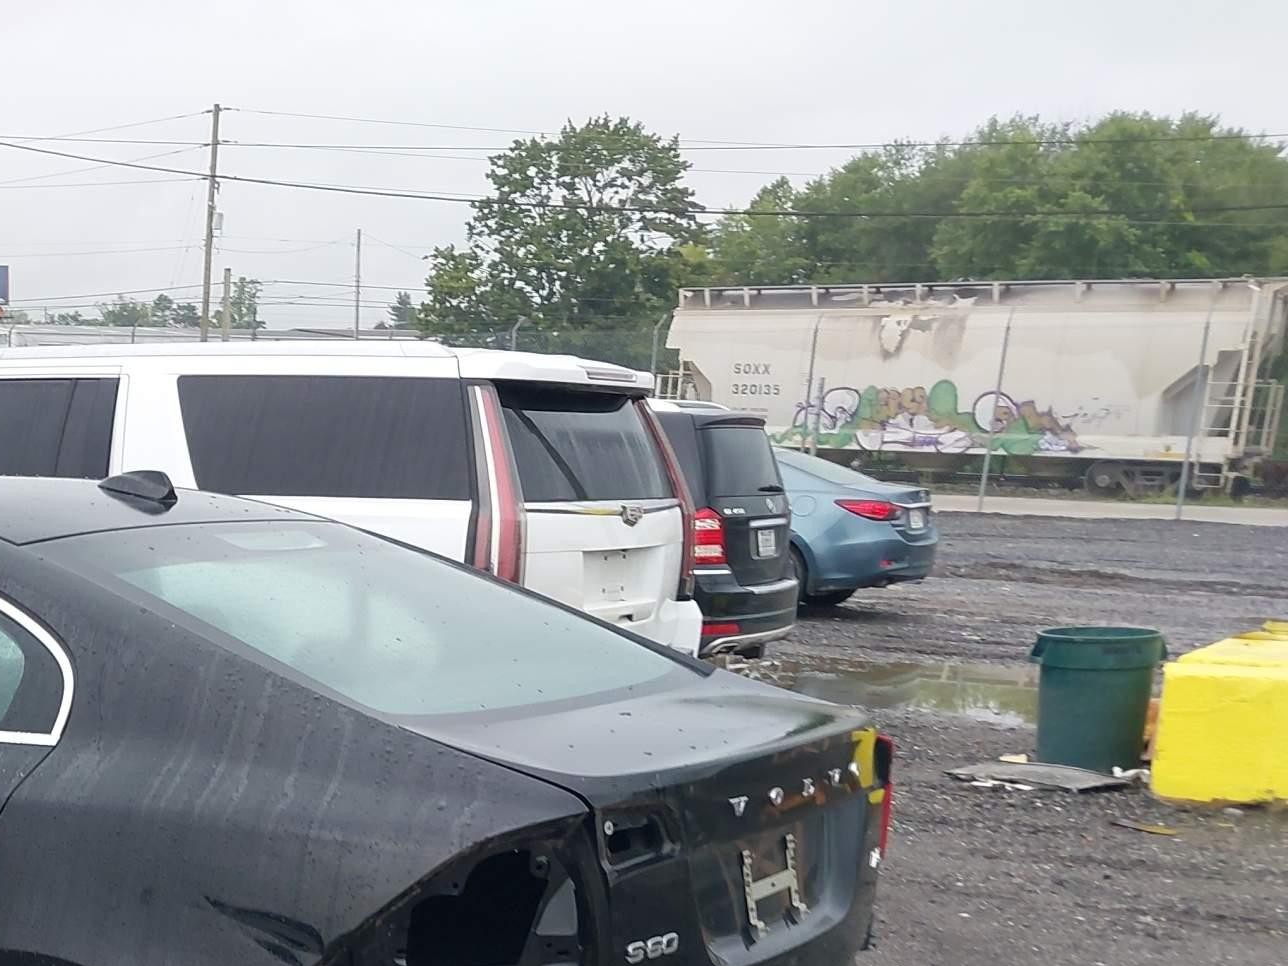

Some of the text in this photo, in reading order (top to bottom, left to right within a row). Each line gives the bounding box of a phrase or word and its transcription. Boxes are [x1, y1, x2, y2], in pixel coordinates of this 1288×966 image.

[733, 363, 772, 375] SOXX
[731, 383, 781, 395] 320135
[624, 932, 679, 964] S60
